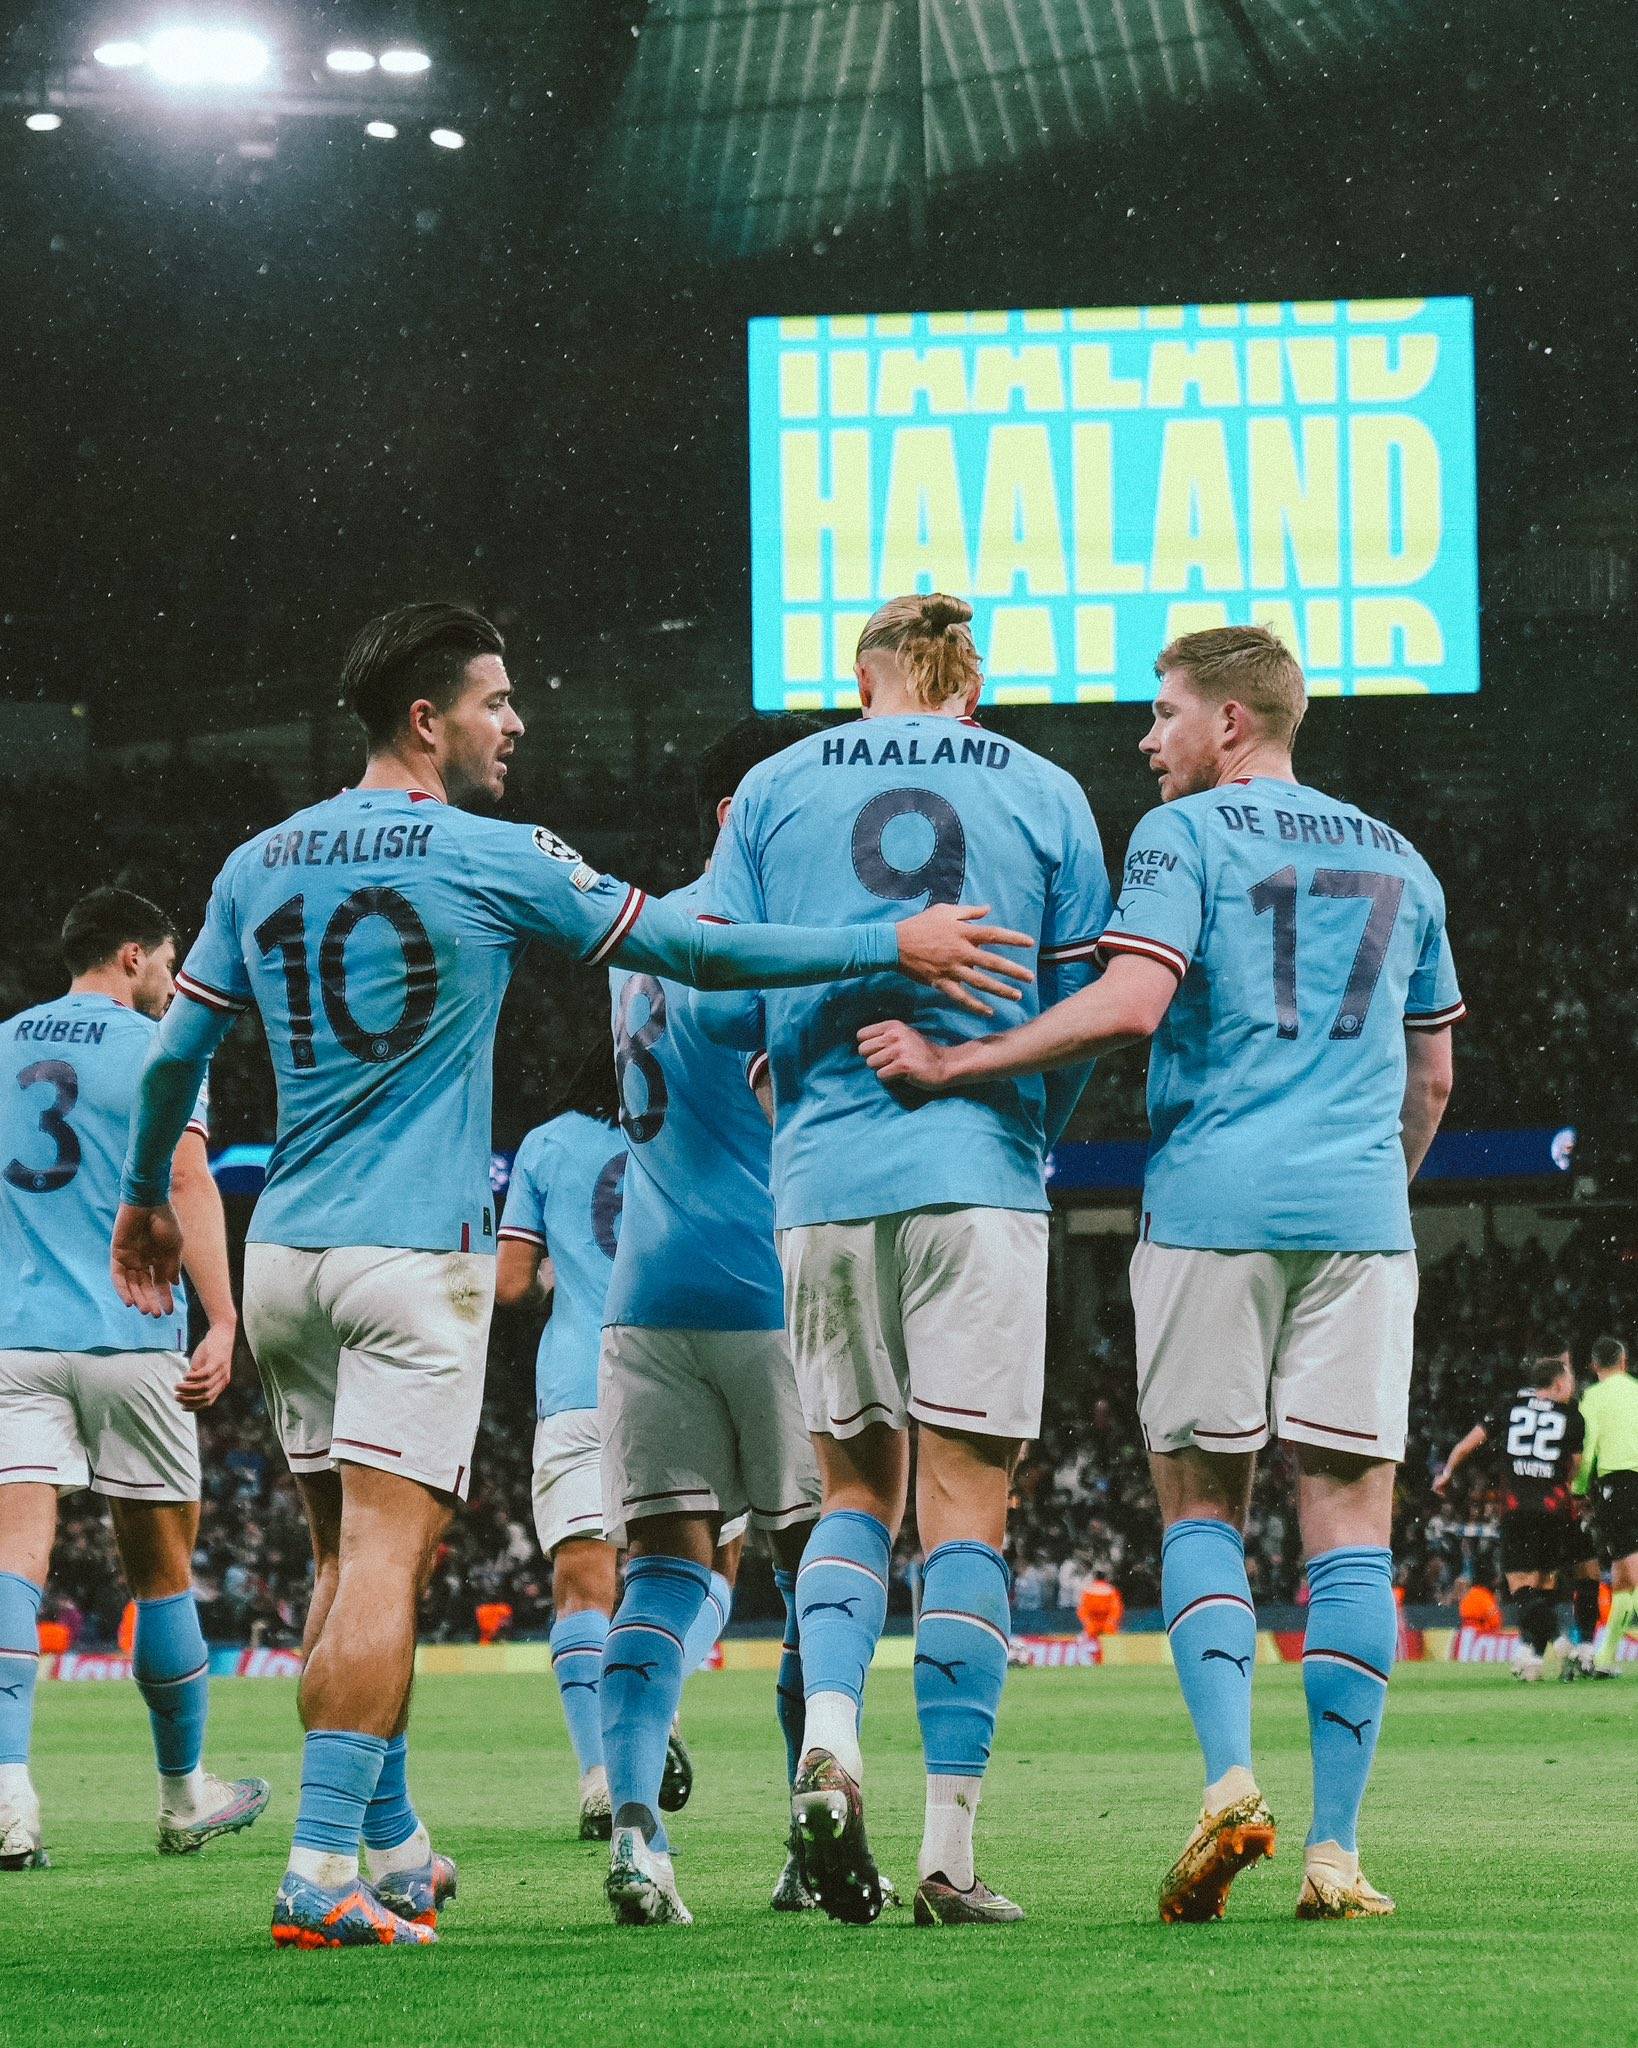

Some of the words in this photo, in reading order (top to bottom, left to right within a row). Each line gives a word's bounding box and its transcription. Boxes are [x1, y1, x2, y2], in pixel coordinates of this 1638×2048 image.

[781, 414, 1442, 602] HAALAND
[822, 737, 1010, 770] HAALAND
[262, 824, 434, 869] GREALISH
[852, 787, 966, 911] 9
[1216, 805, 1265, 836] DE
[1274, 809, 1408, 857] BRUYNE
[1125, 868, 1159, 886] RE
[1126, 849, 1178, 872] EXEN
[254, 886, 437, 1069] 10
[1247, 864, 1405, 1040] 17
[14, 1014, 107, 1045] RÚBEN
[3, 1059, 82, 1193] 3
[1506, 1405, 1567, 1461] 22
